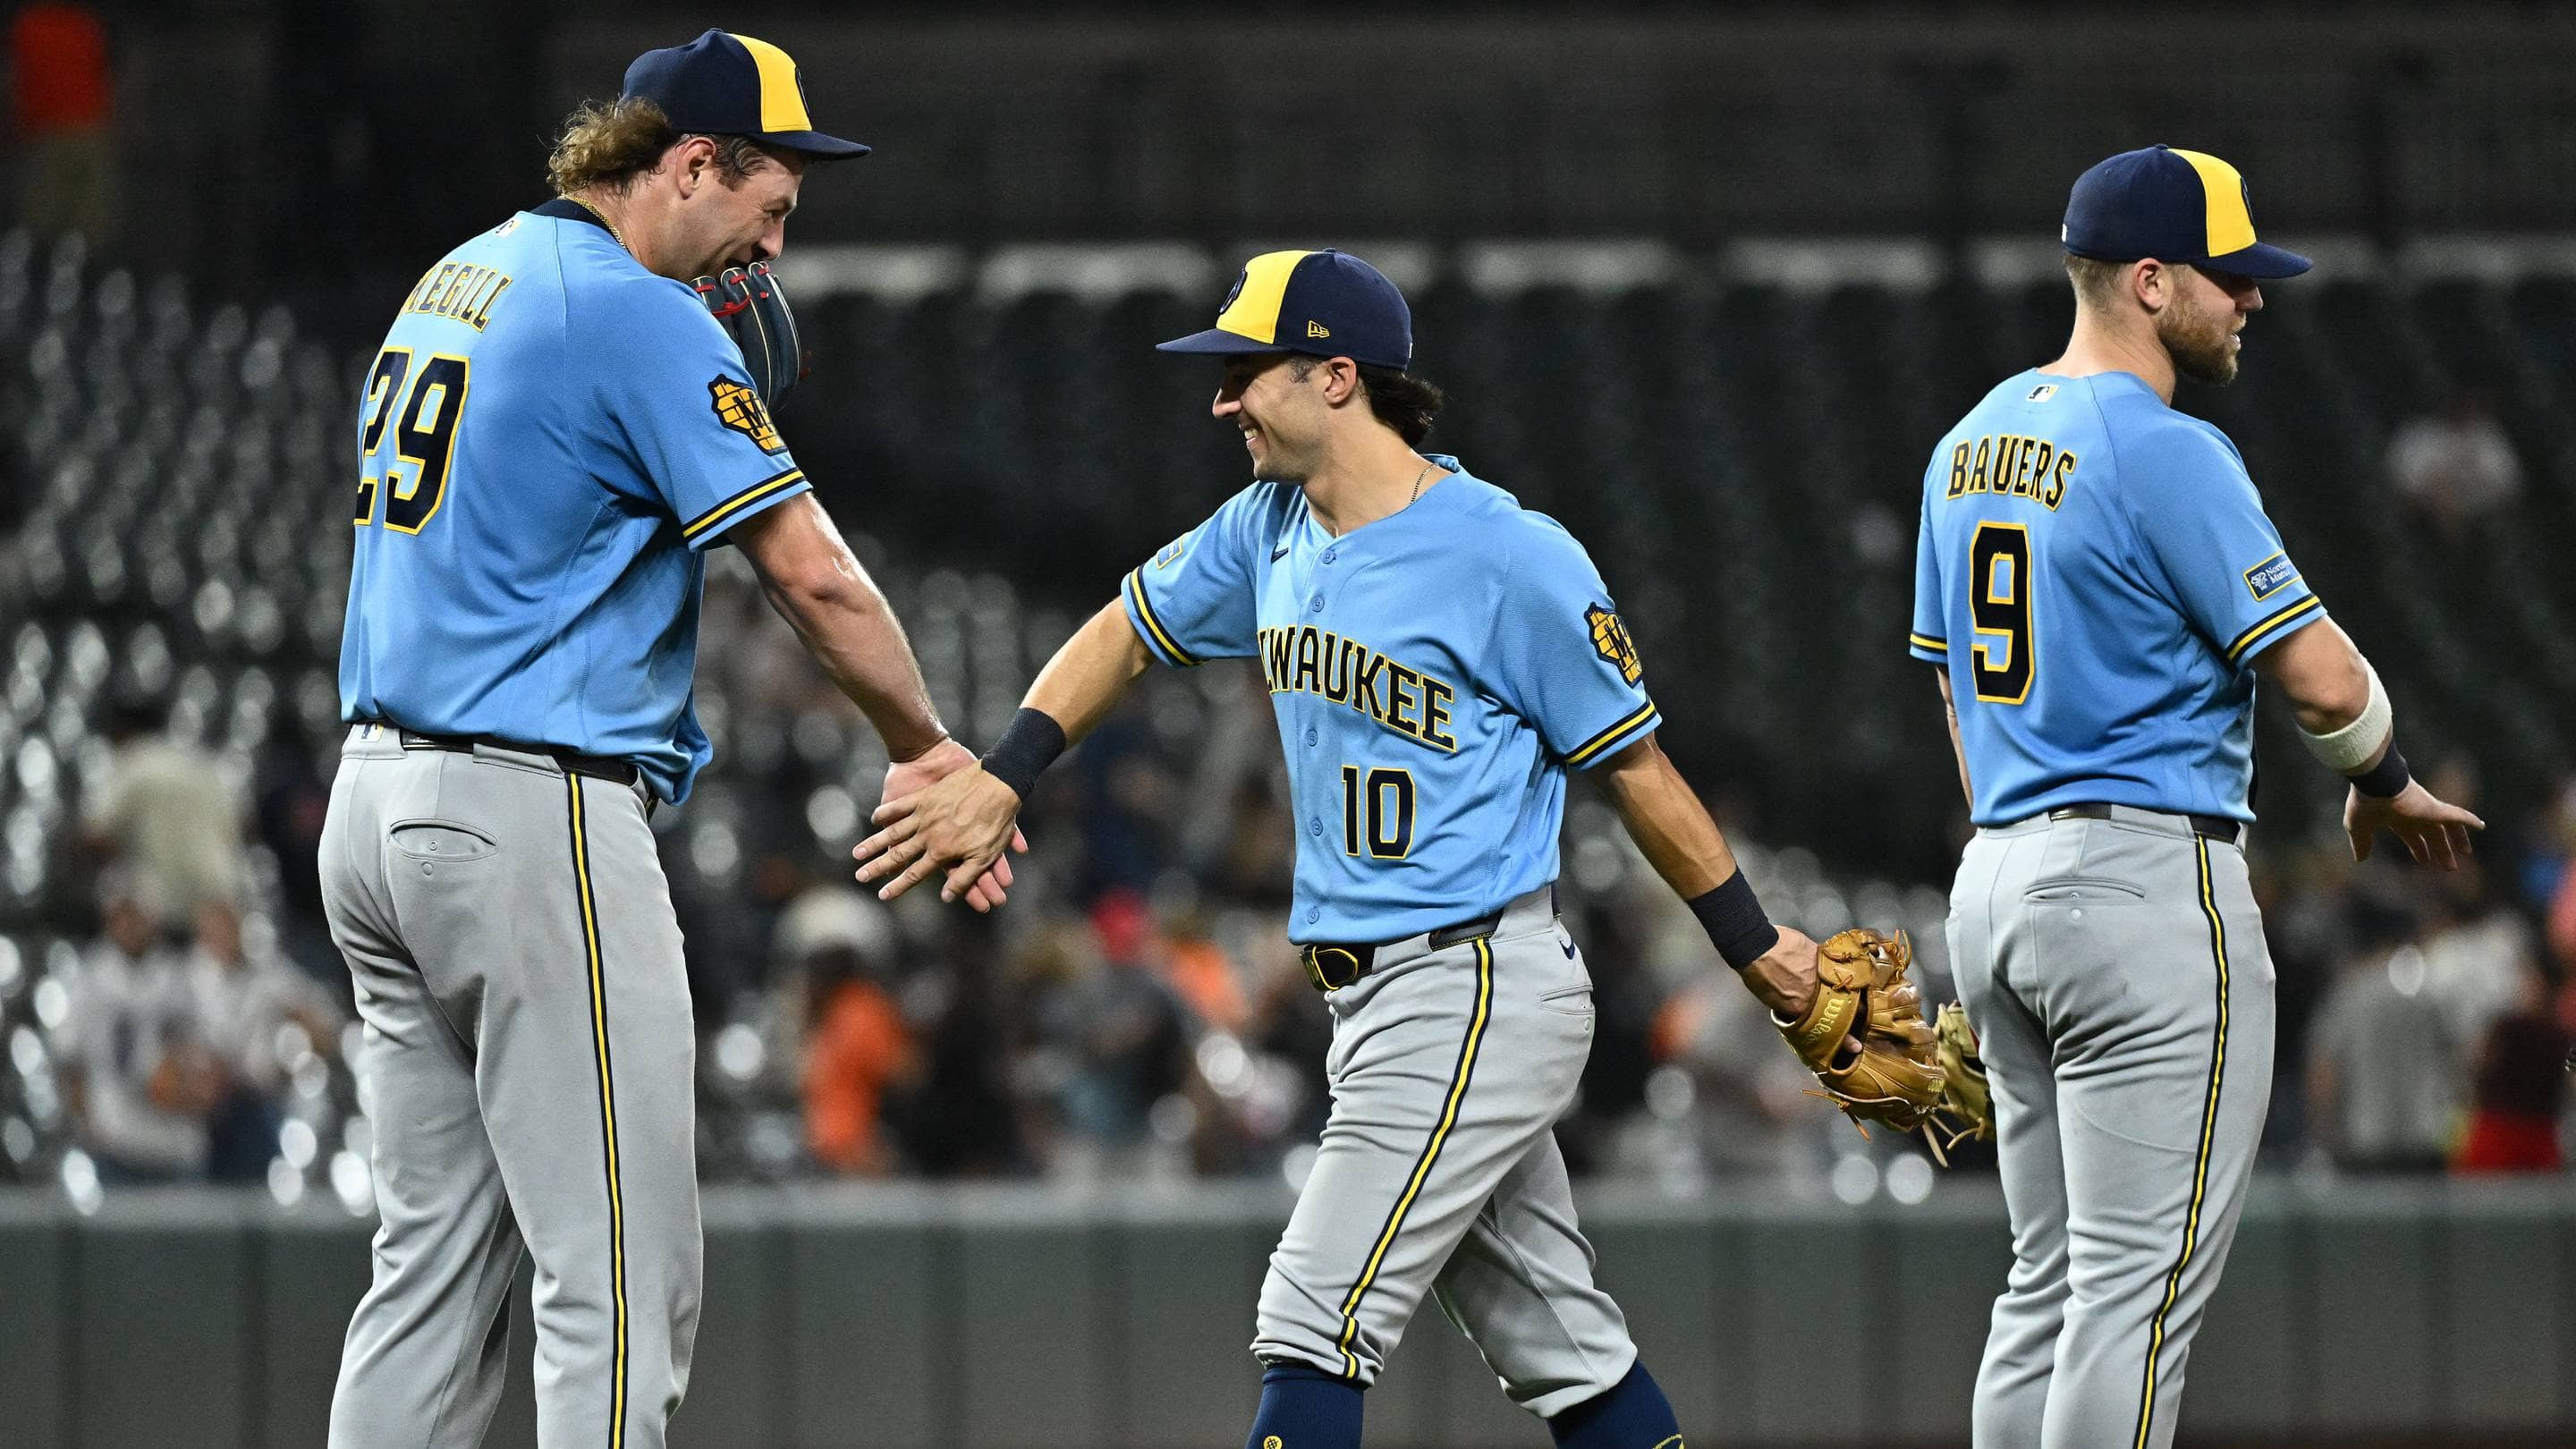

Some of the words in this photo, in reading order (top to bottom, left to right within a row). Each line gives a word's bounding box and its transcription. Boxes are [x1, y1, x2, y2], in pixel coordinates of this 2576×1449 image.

[353, 345, 470, 536] 29
[1946, 434, 2077, 512] BAUERS
[1970, 521, 2035, 705] 9
[1342, 764, 1416, 860] 10
